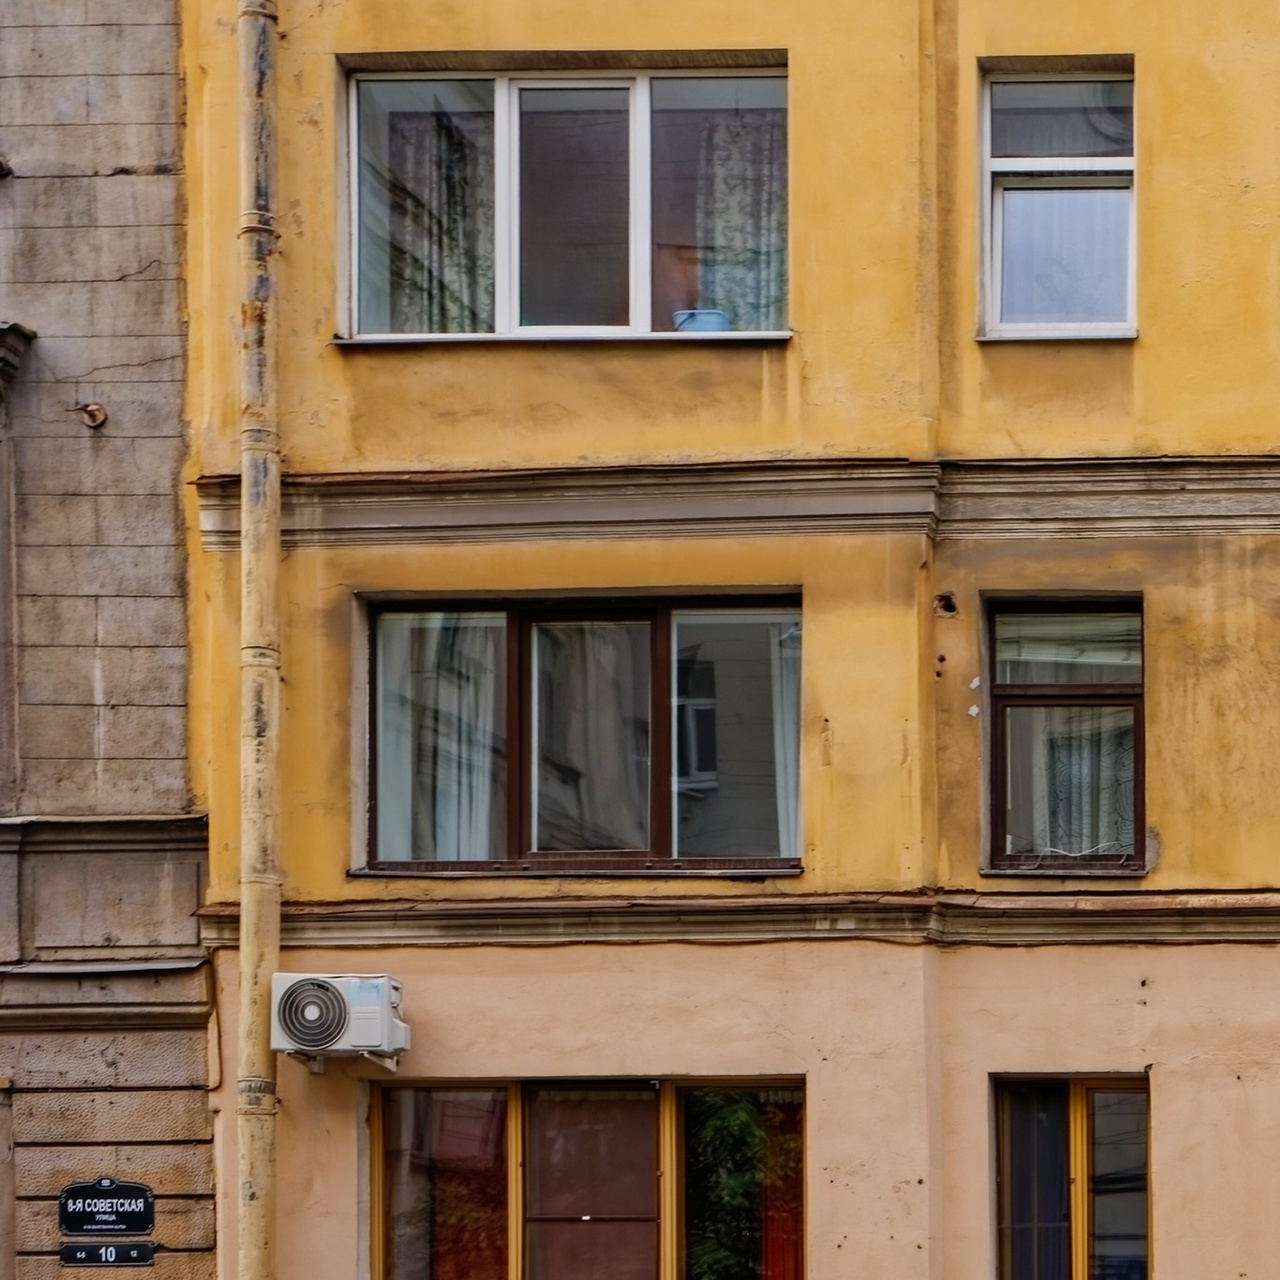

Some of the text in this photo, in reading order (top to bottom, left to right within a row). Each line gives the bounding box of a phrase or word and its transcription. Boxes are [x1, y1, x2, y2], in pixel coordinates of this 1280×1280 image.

[67, 1199, 144, 1212] 8-Я СОВЕТСКАЯ
[98, 1246, 116, 1262] 10
